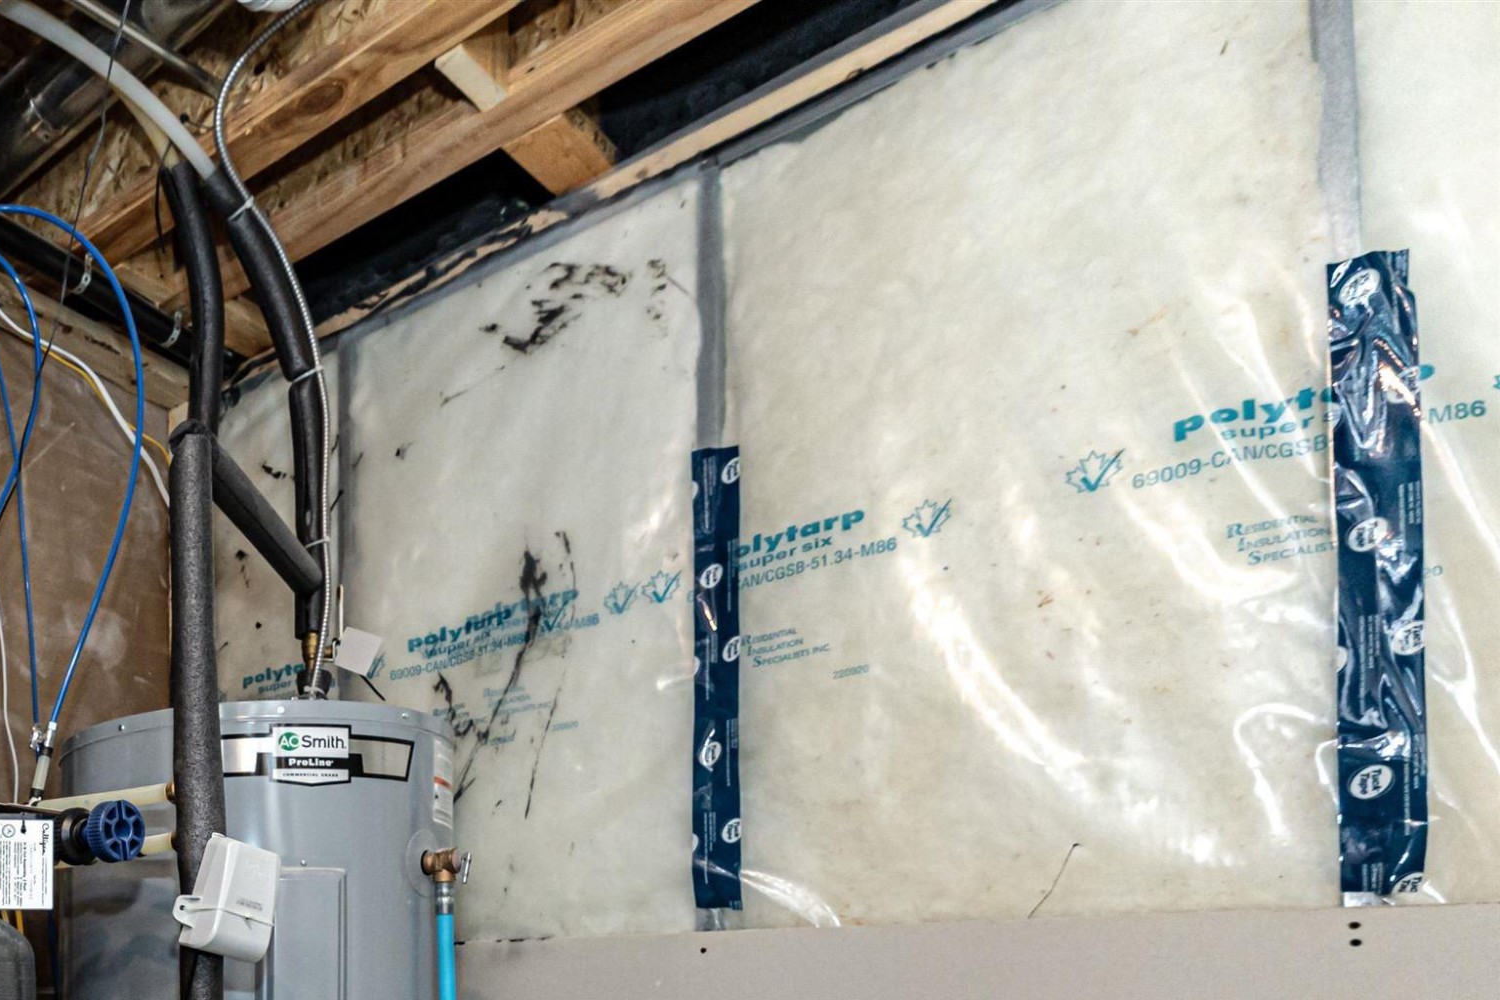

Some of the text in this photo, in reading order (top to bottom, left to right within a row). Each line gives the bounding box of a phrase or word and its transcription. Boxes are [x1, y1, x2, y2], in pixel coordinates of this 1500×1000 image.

[802, 536, 833, 553] six
[1247, 540, 1337, 566] SPECIALIST
[288, 757, 334, 767] ProLine
